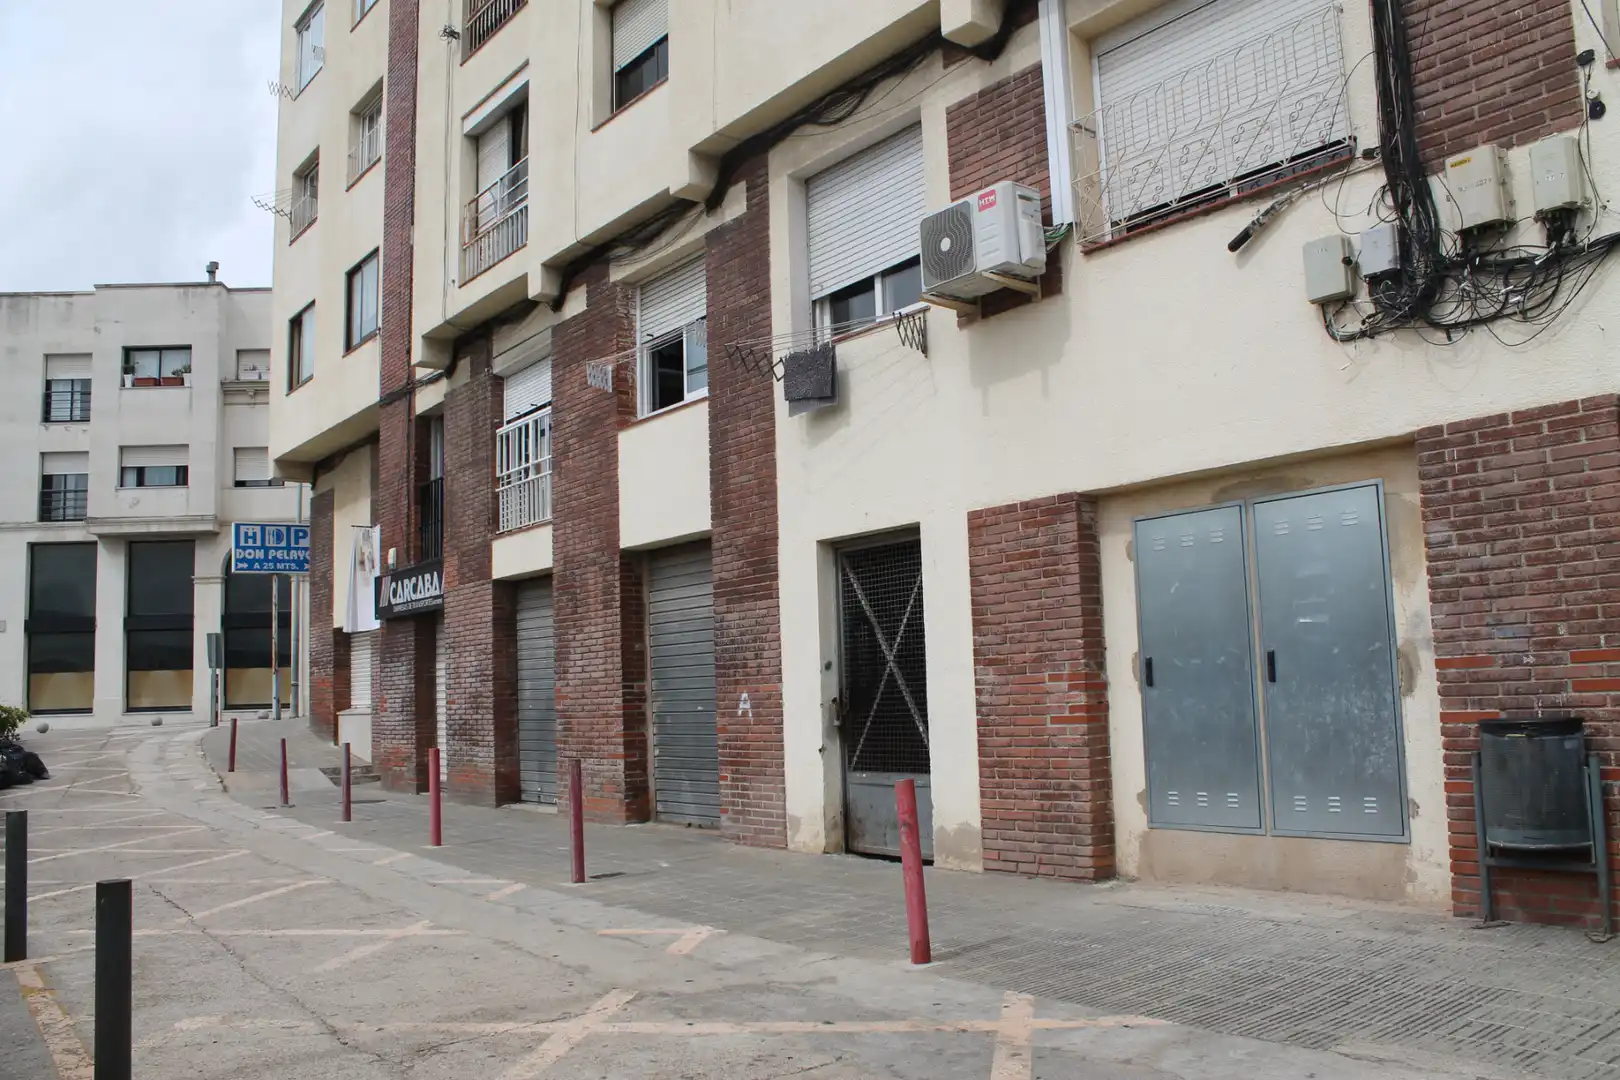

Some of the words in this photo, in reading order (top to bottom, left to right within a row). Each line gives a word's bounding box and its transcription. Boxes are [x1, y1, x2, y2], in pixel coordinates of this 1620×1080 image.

[294, 529, 308, 545] P
[236, 549, 264, 559] DON
[262, 562, 275, 570] 25
[276, 562, 299, 570] MTS.
[390, 571, 440, 605] CARCABA
